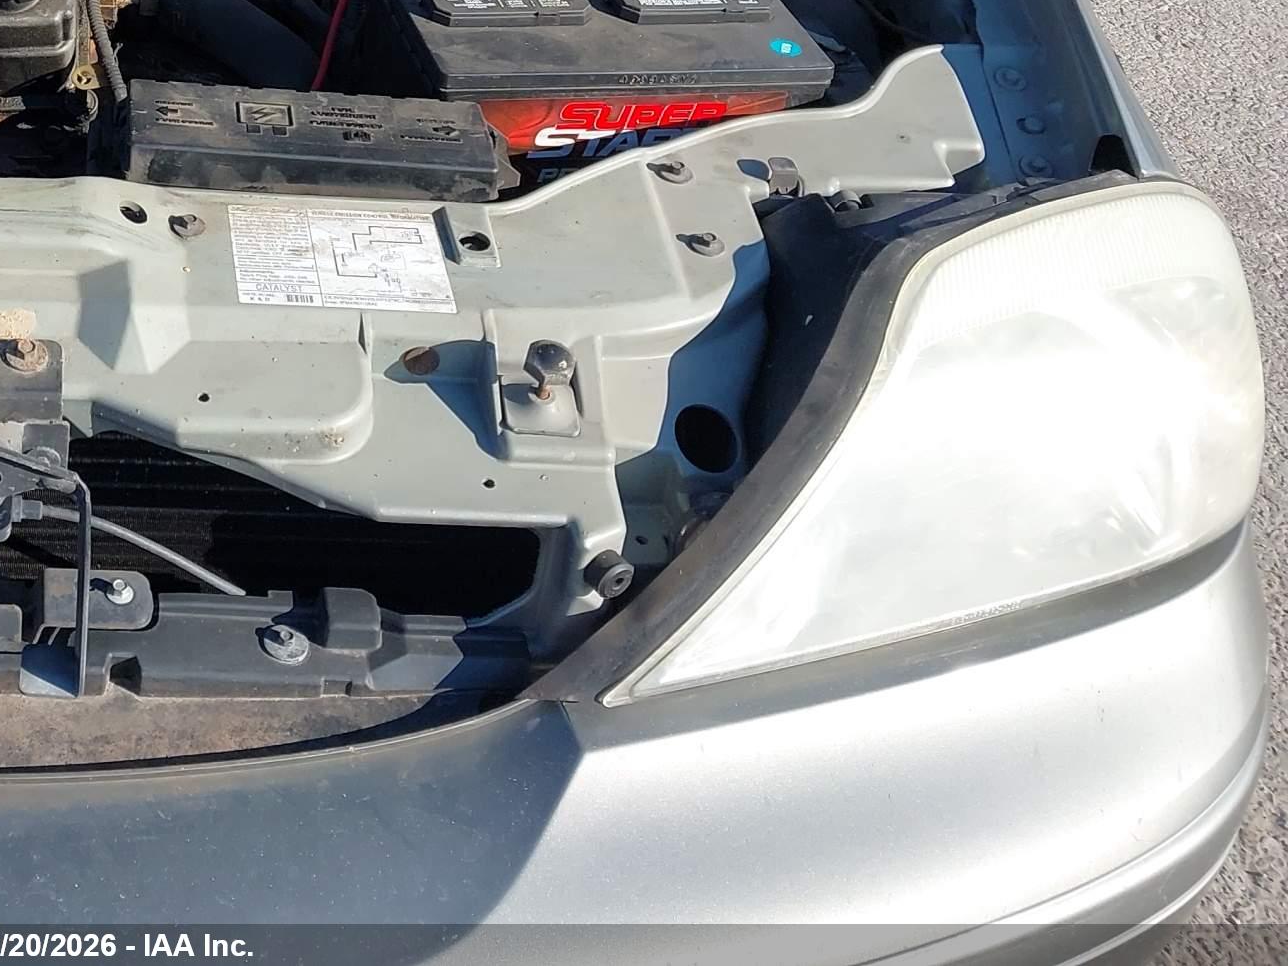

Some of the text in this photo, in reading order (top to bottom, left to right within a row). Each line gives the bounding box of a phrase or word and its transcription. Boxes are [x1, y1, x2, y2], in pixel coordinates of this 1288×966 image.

[555, 101, 728, 131] SUPER
[527, 127, 698, 159] STAR
[255, 283, 302, 293] CATALYST
